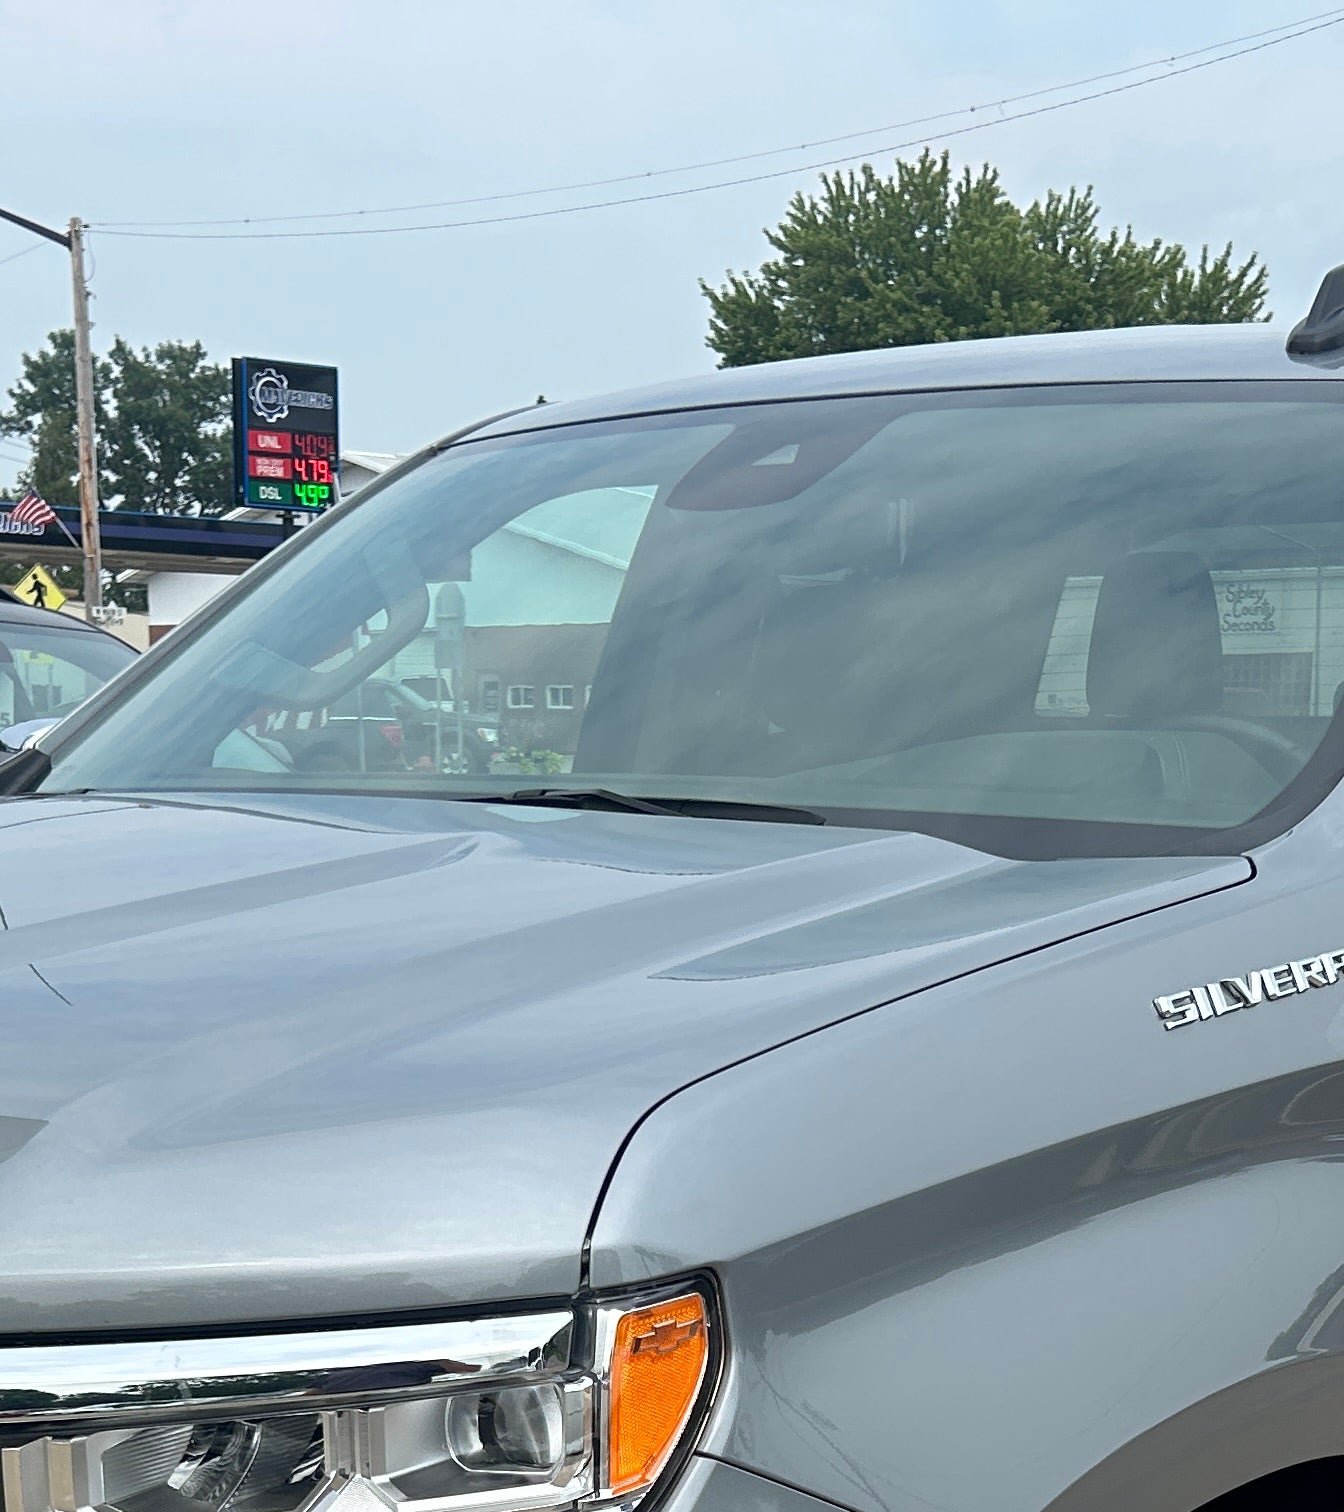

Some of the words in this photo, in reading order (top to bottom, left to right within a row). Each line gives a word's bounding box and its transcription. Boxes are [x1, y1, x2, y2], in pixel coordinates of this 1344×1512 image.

[257, 434, 283, 449] UNL
[259, 485, 283, 500] DSL
[1222, 613, 1276, 632] Seconds
